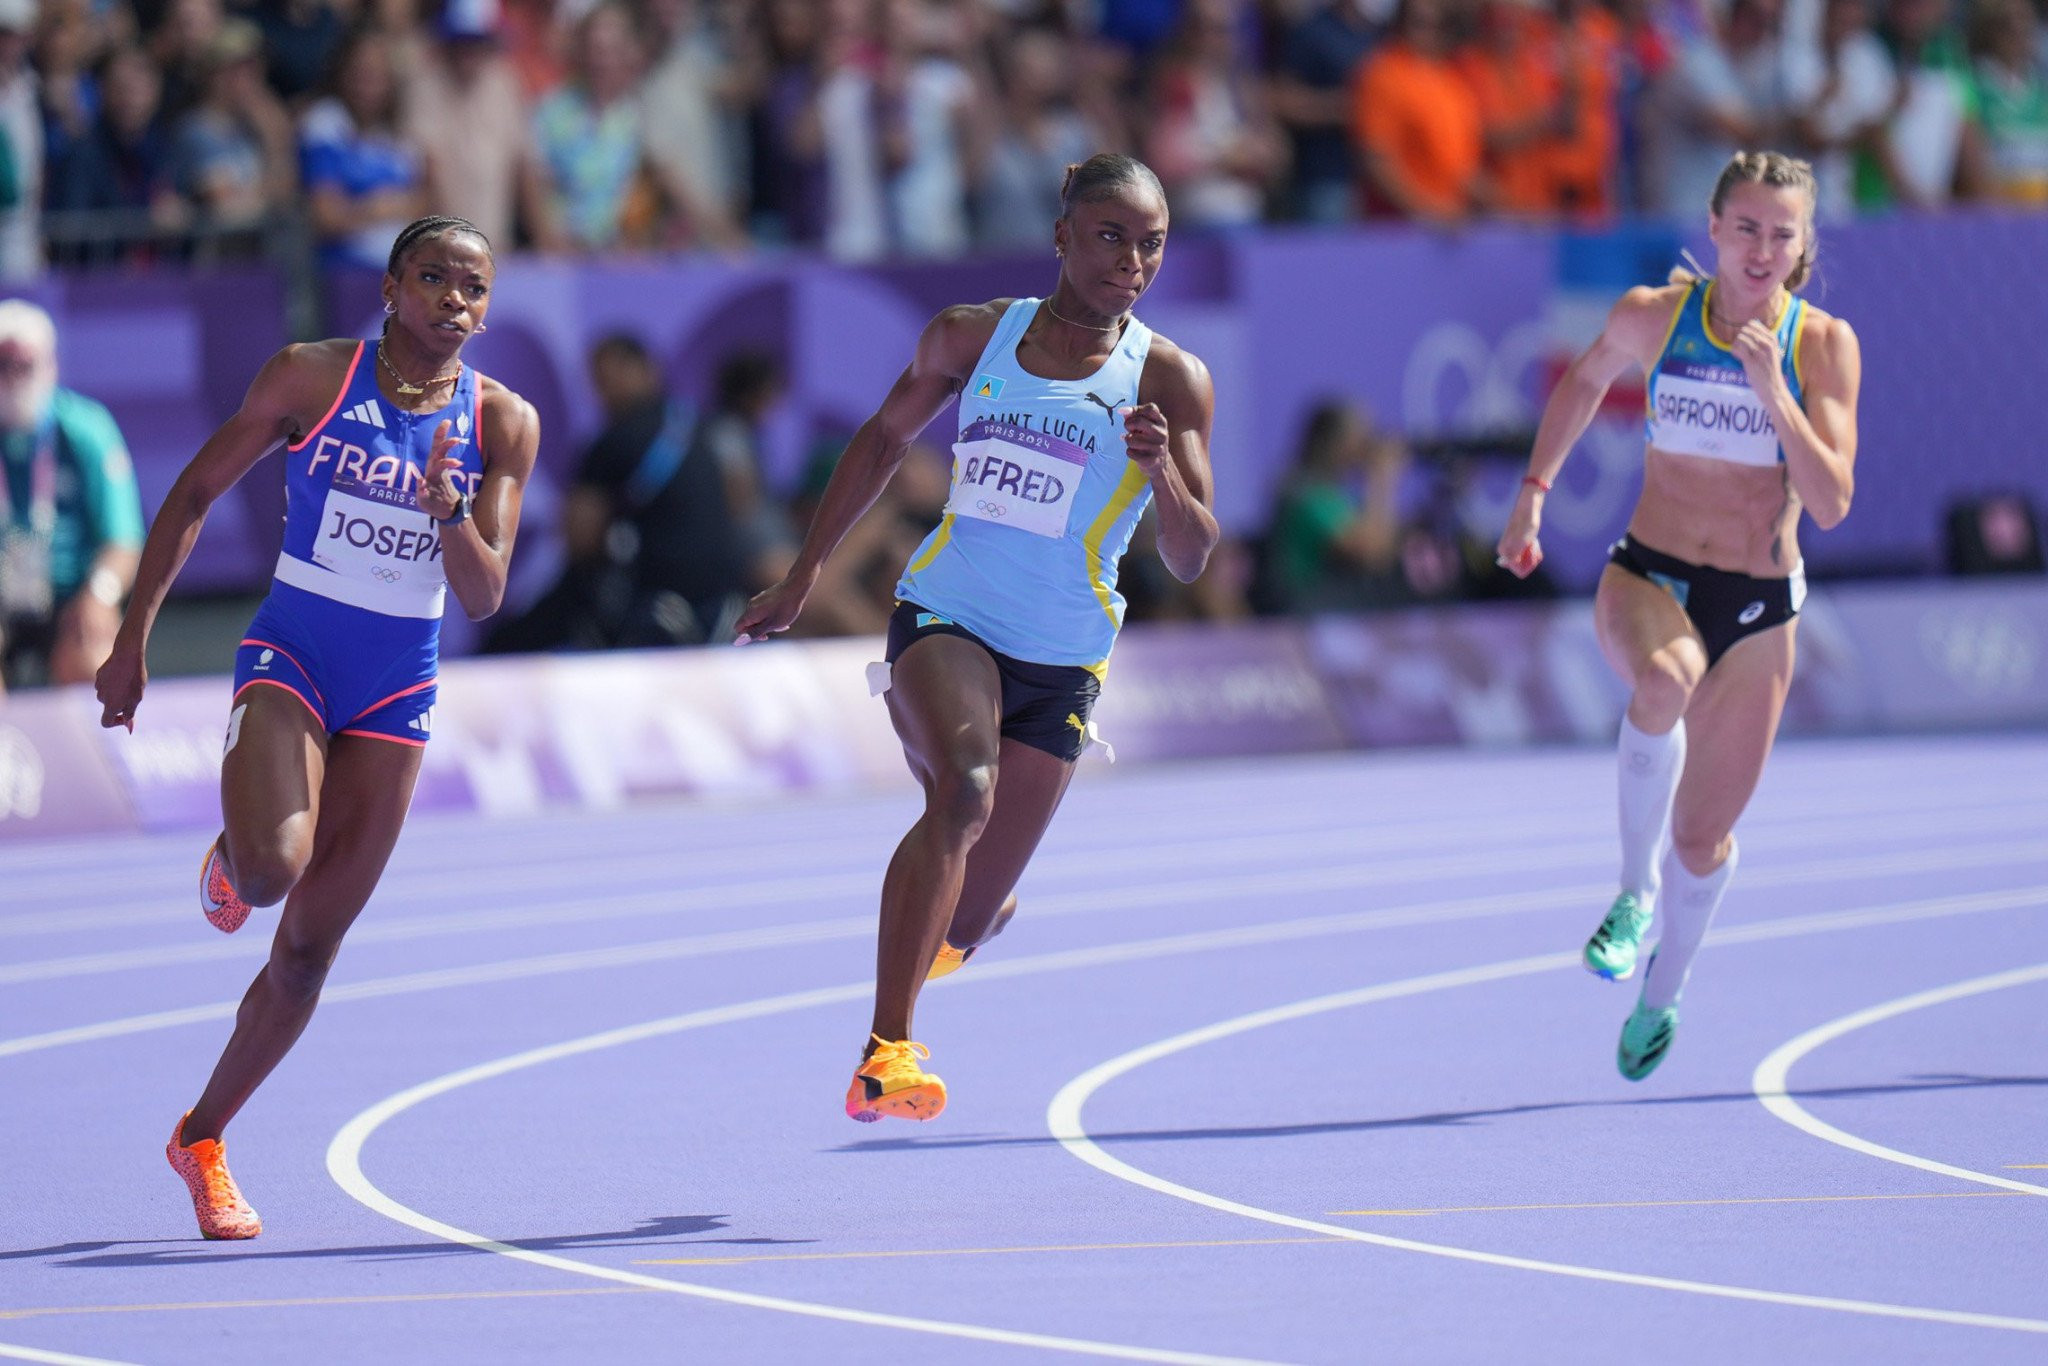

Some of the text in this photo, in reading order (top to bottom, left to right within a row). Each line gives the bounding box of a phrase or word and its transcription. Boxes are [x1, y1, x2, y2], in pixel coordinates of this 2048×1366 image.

[1018, 432, 1050, 449] 2024
[1043, 416, 1097, 453] LUCIA
[960, 456, 1065, 504] ALFRED
